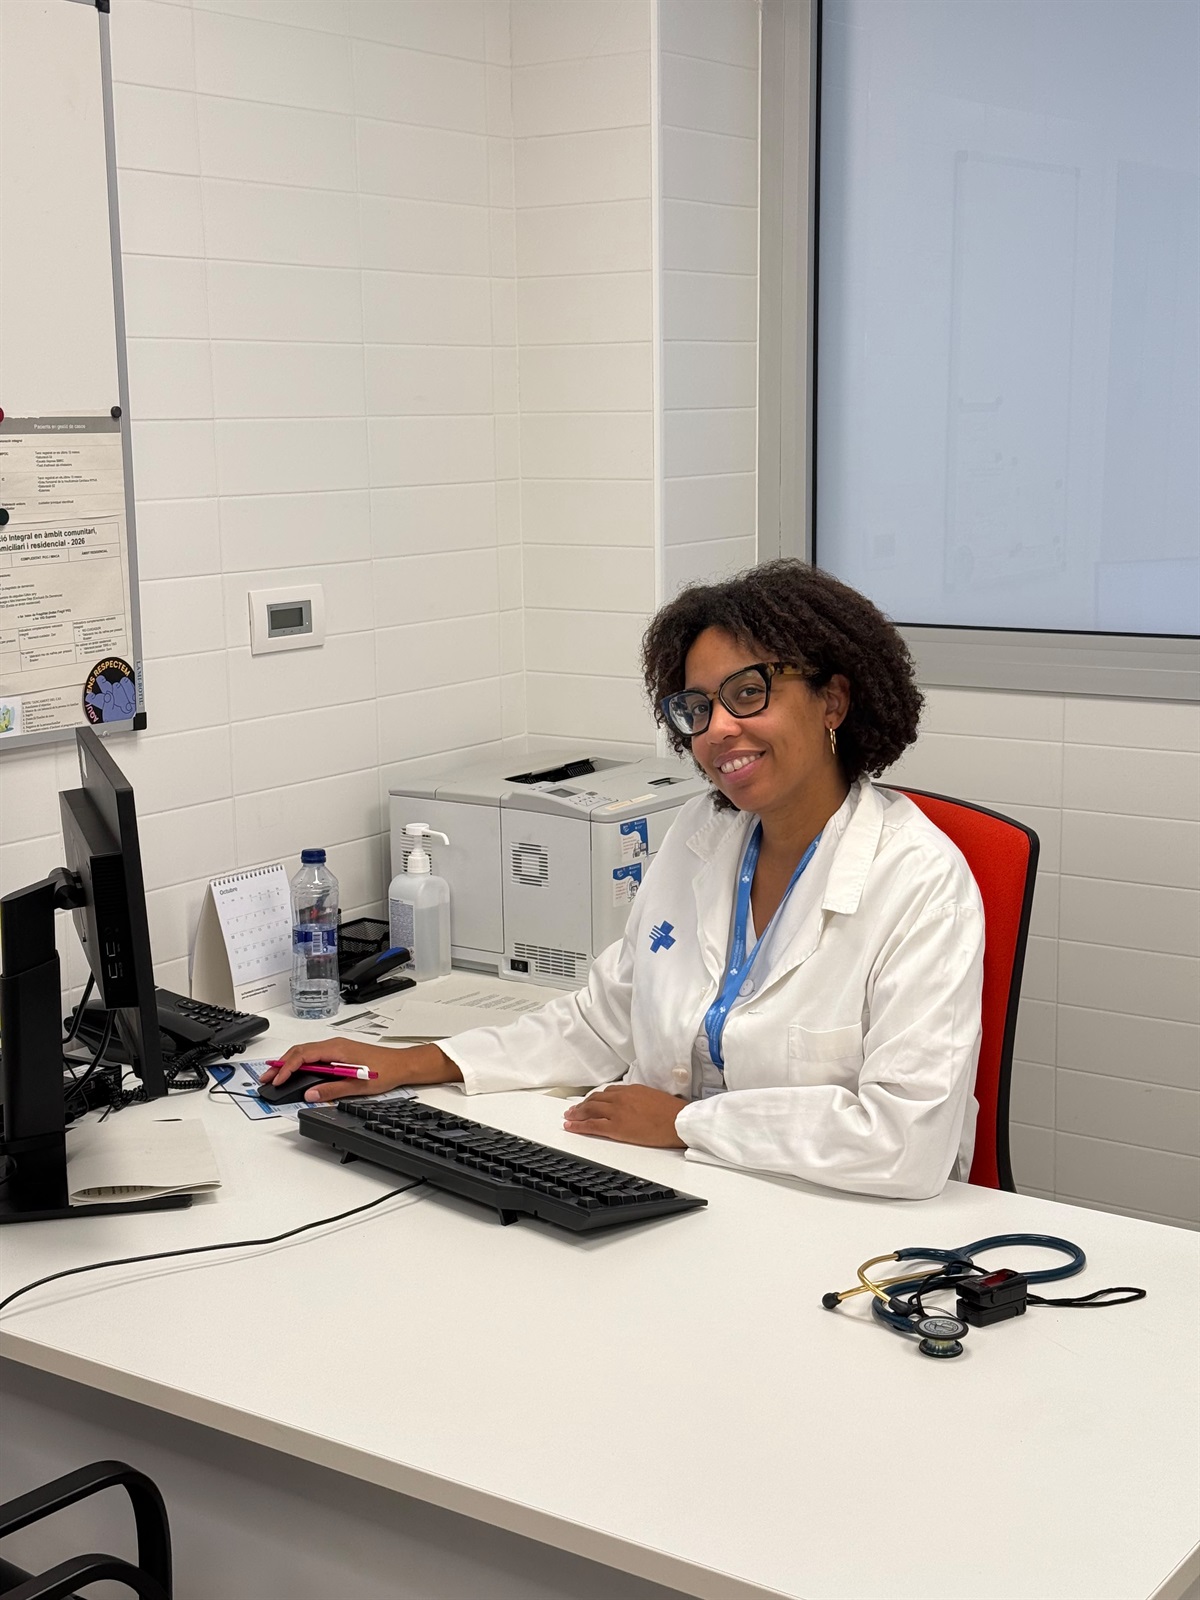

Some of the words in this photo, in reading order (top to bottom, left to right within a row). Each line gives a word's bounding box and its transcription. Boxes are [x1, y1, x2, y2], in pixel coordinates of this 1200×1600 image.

[9, 532, 33, 542] Integral
[44, 530, 62, 538] àmbit
[64, 527, 97, 536] comunitari,
[31, 540, 66, 549] residencial
[86, 676, 95, 693] ENS
[93, 660, 130, 677] RESPECTEM
[219, 887, 237, 895] Octubre
